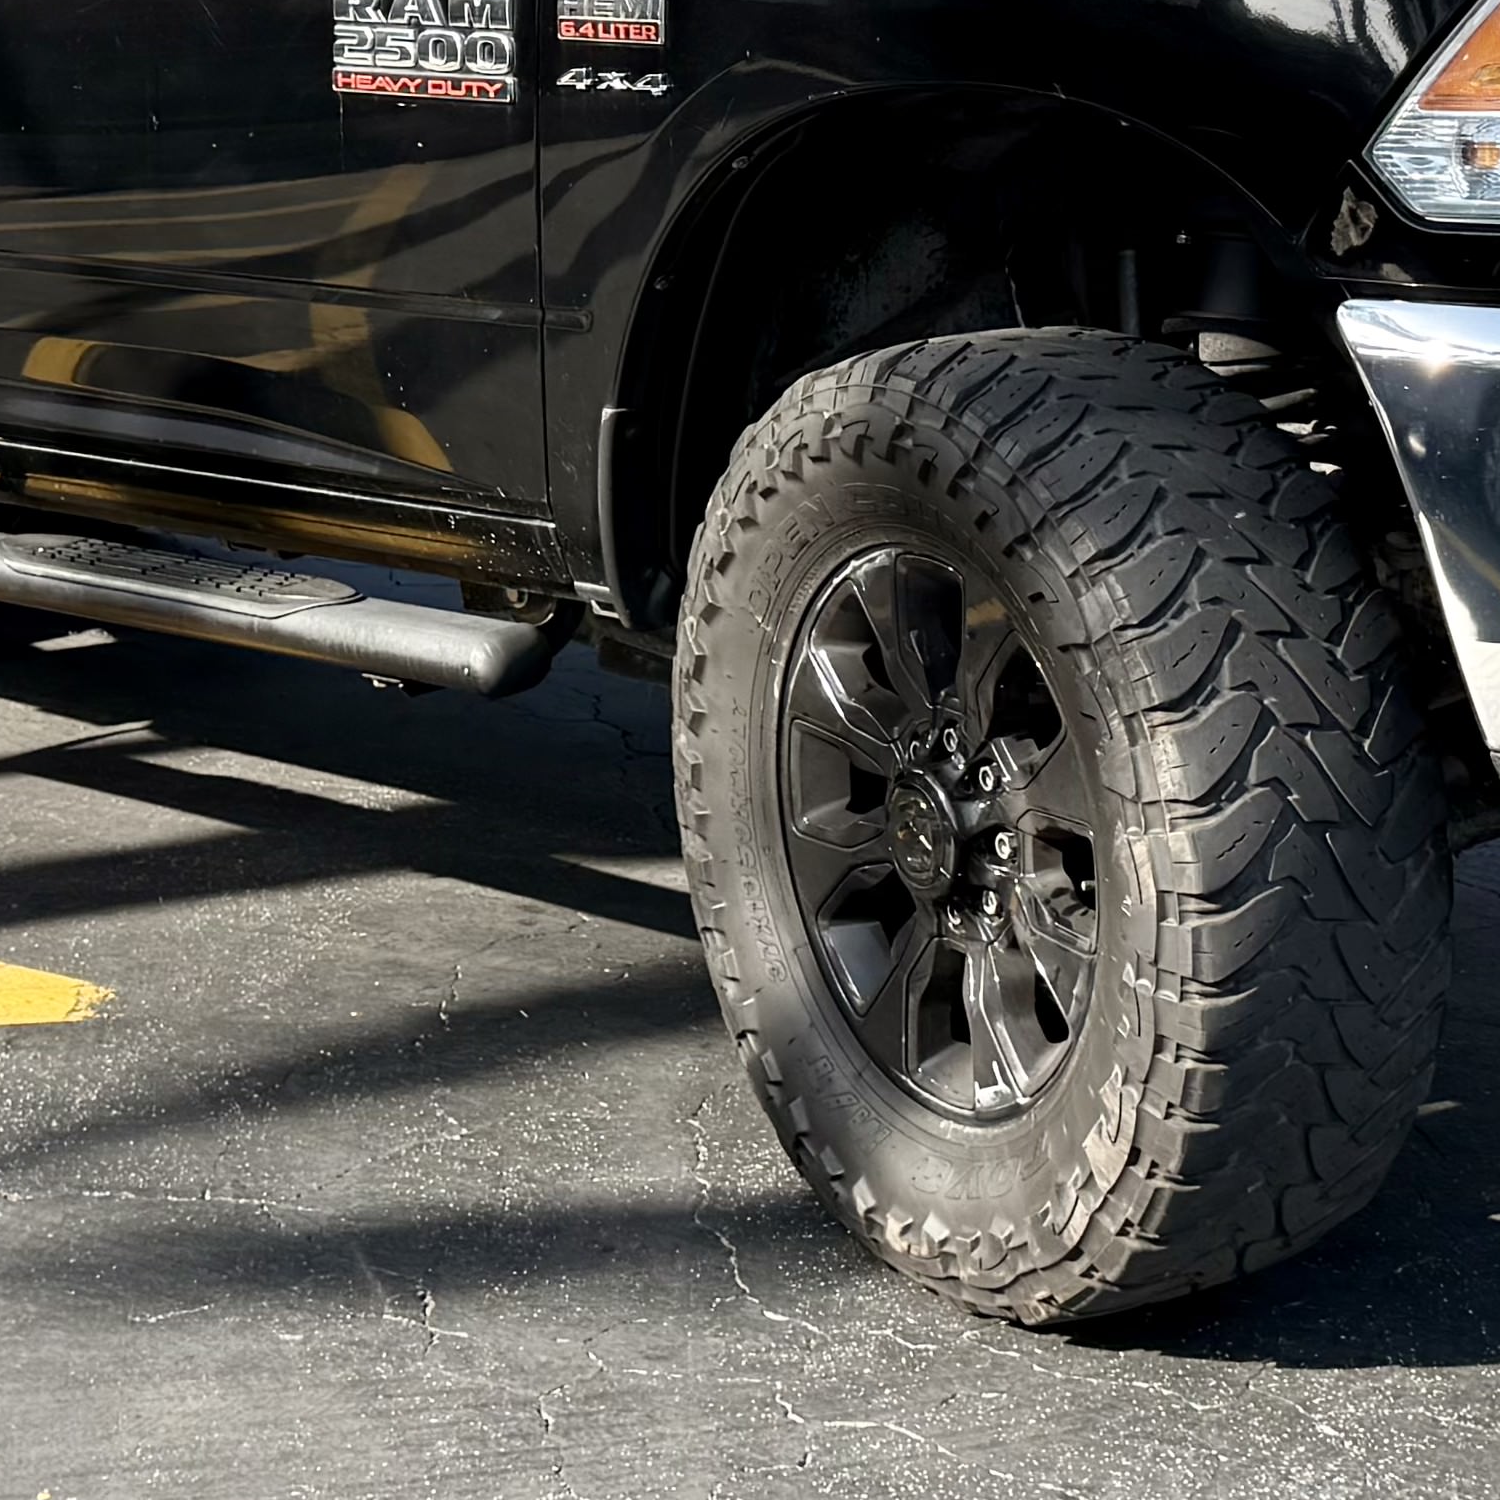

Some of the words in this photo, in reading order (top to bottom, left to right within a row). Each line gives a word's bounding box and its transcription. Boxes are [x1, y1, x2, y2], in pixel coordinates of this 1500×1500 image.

[560, 21, 594, 38] 6.4
[597, 22, 657, 41] LITER
[333, 25, 515, 74] 2500
[337, 73, 422, 94] HEAVY
[427, 78, 503, 99] DUTY
